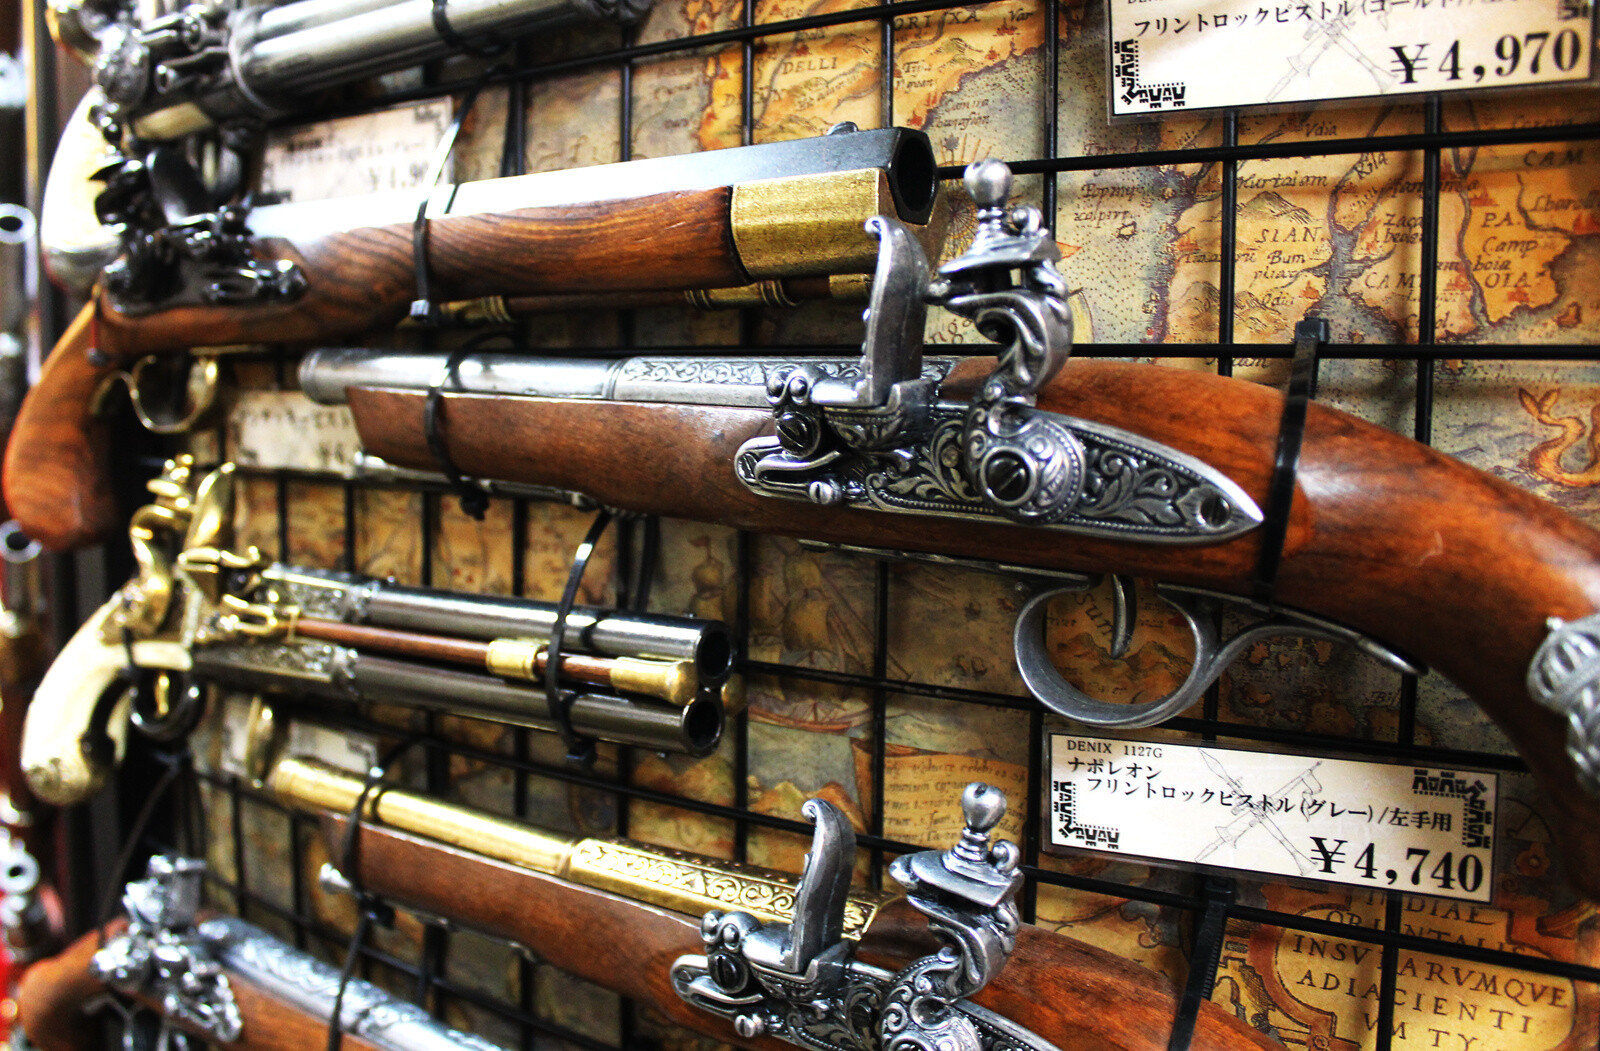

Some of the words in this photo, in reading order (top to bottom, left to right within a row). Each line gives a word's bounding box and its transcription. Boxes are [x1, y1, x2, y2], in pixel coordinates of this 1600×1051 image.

[1389, 28, 1582, 84] ¥4,970
[1067, 739, 1112, 754] DENIX
[1124, 744, 1163, 758] 1127G
[1067, 756, 1163, 780] ナポレオン
[1309, 836, 1484, 893] ¥4,740
